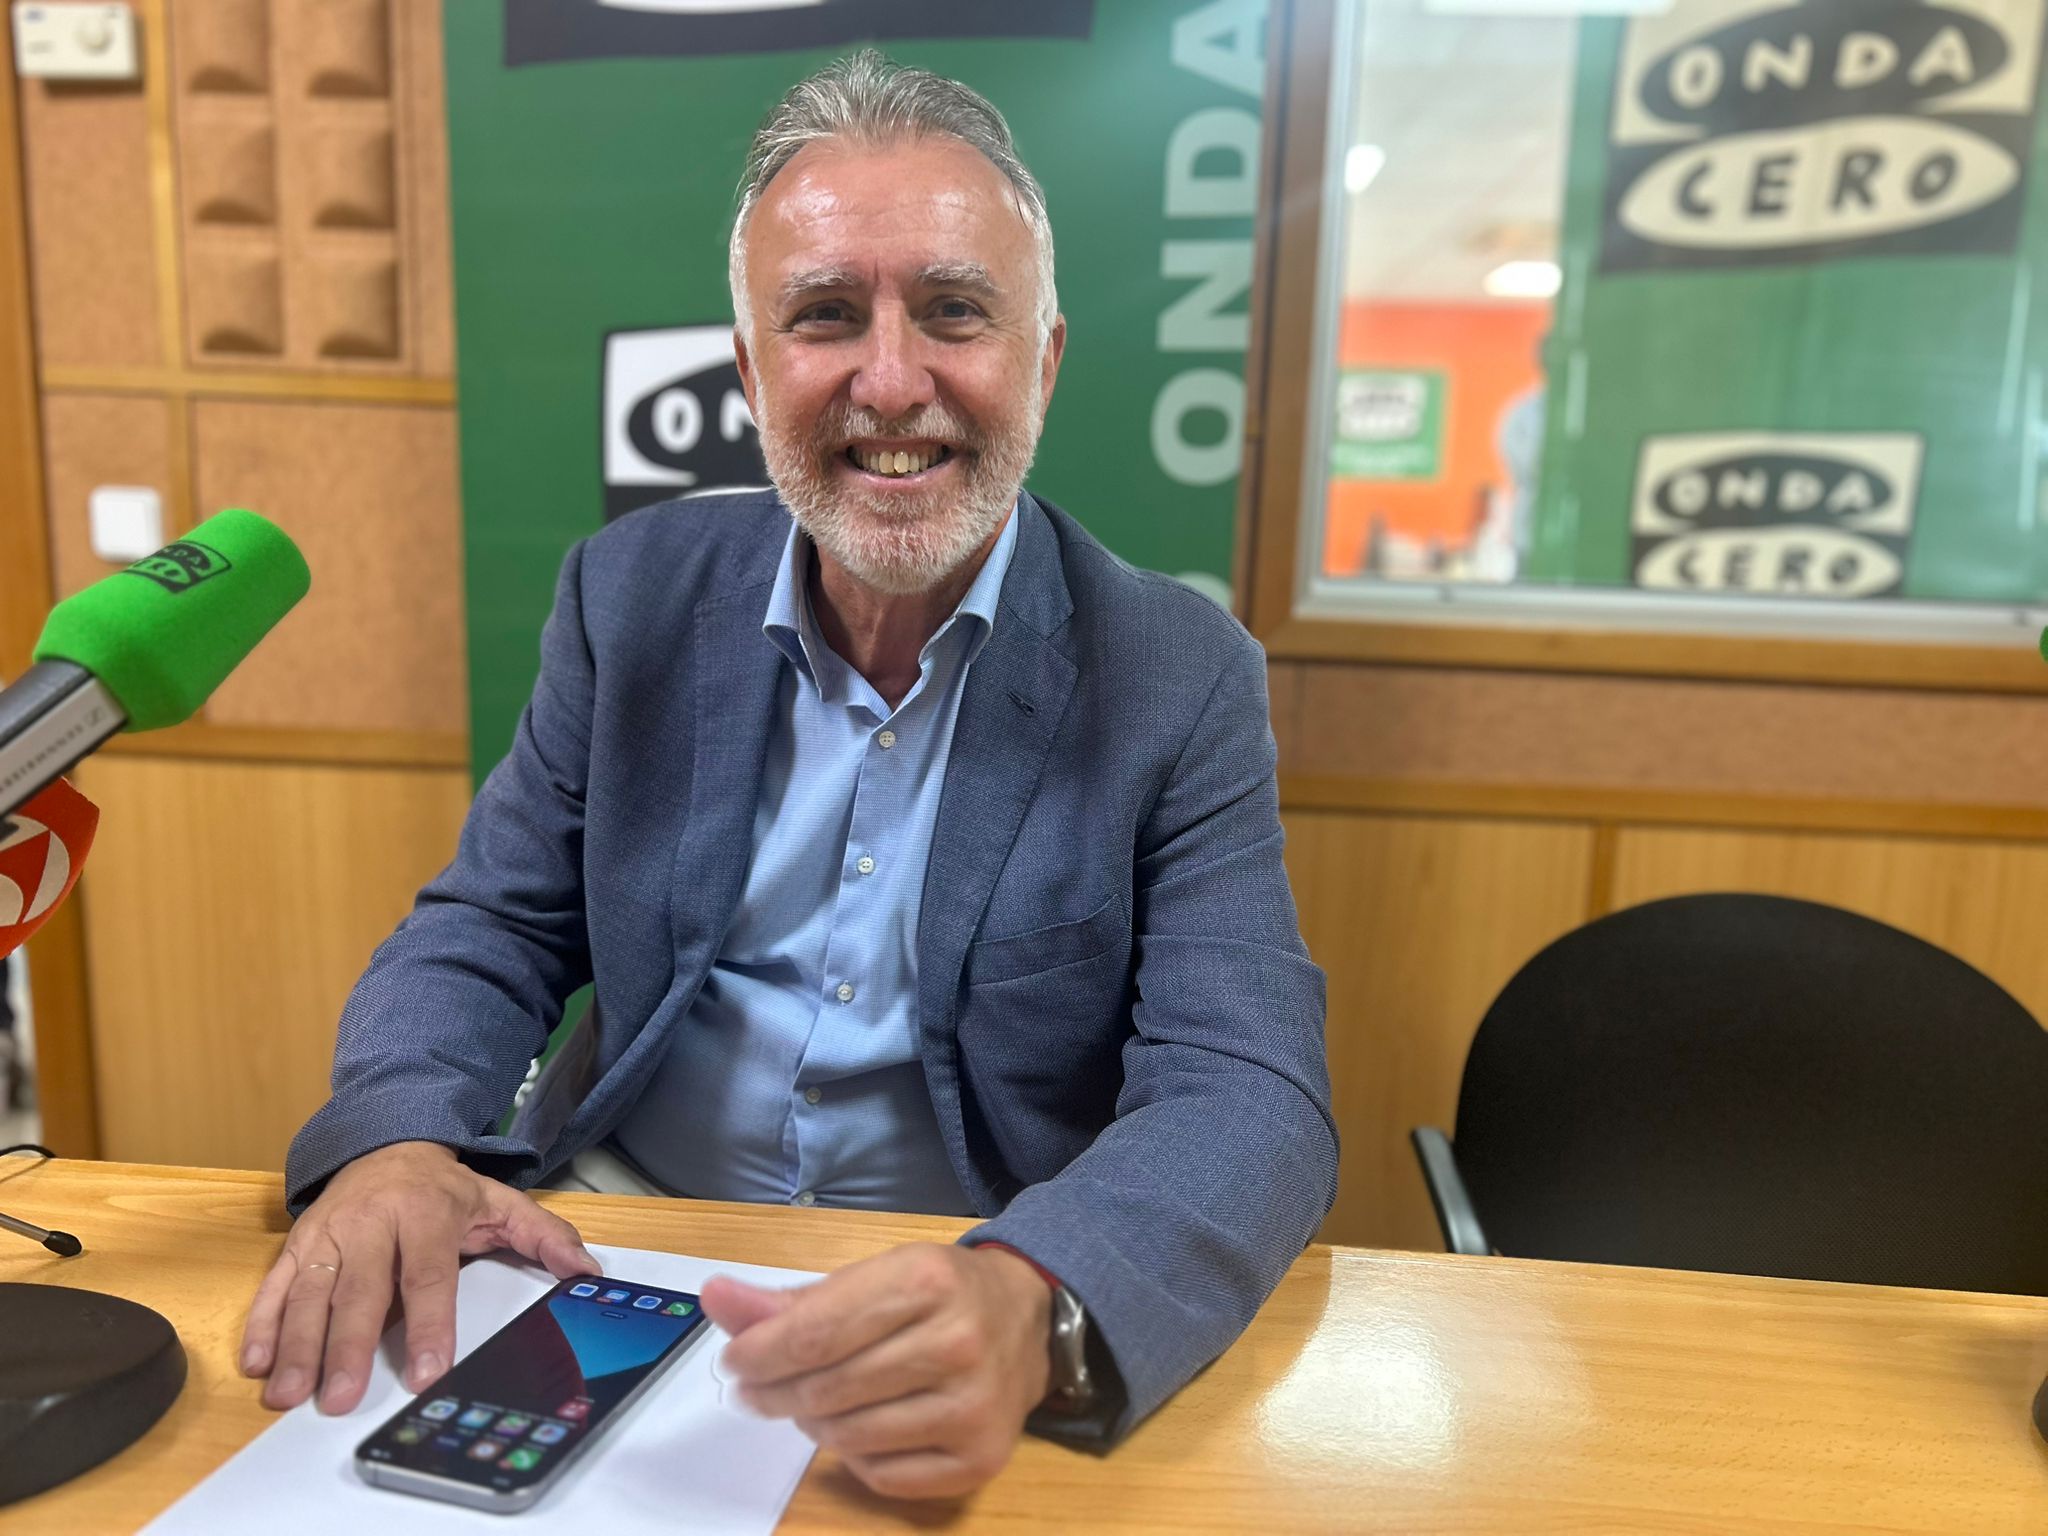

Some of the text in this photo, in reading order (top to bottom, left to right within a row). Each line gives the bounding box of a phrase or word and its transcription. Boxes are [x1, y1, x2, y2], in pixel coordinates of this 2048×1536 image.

[1668, 26, 1974, 108] ONDA
[1674, 146, 1959, 222] CERO
[1151, 0, 1265, 486] ONDA
[1667, 467, 1875, 516] ONDA
[1675, 544, 1862, 592] CERO
